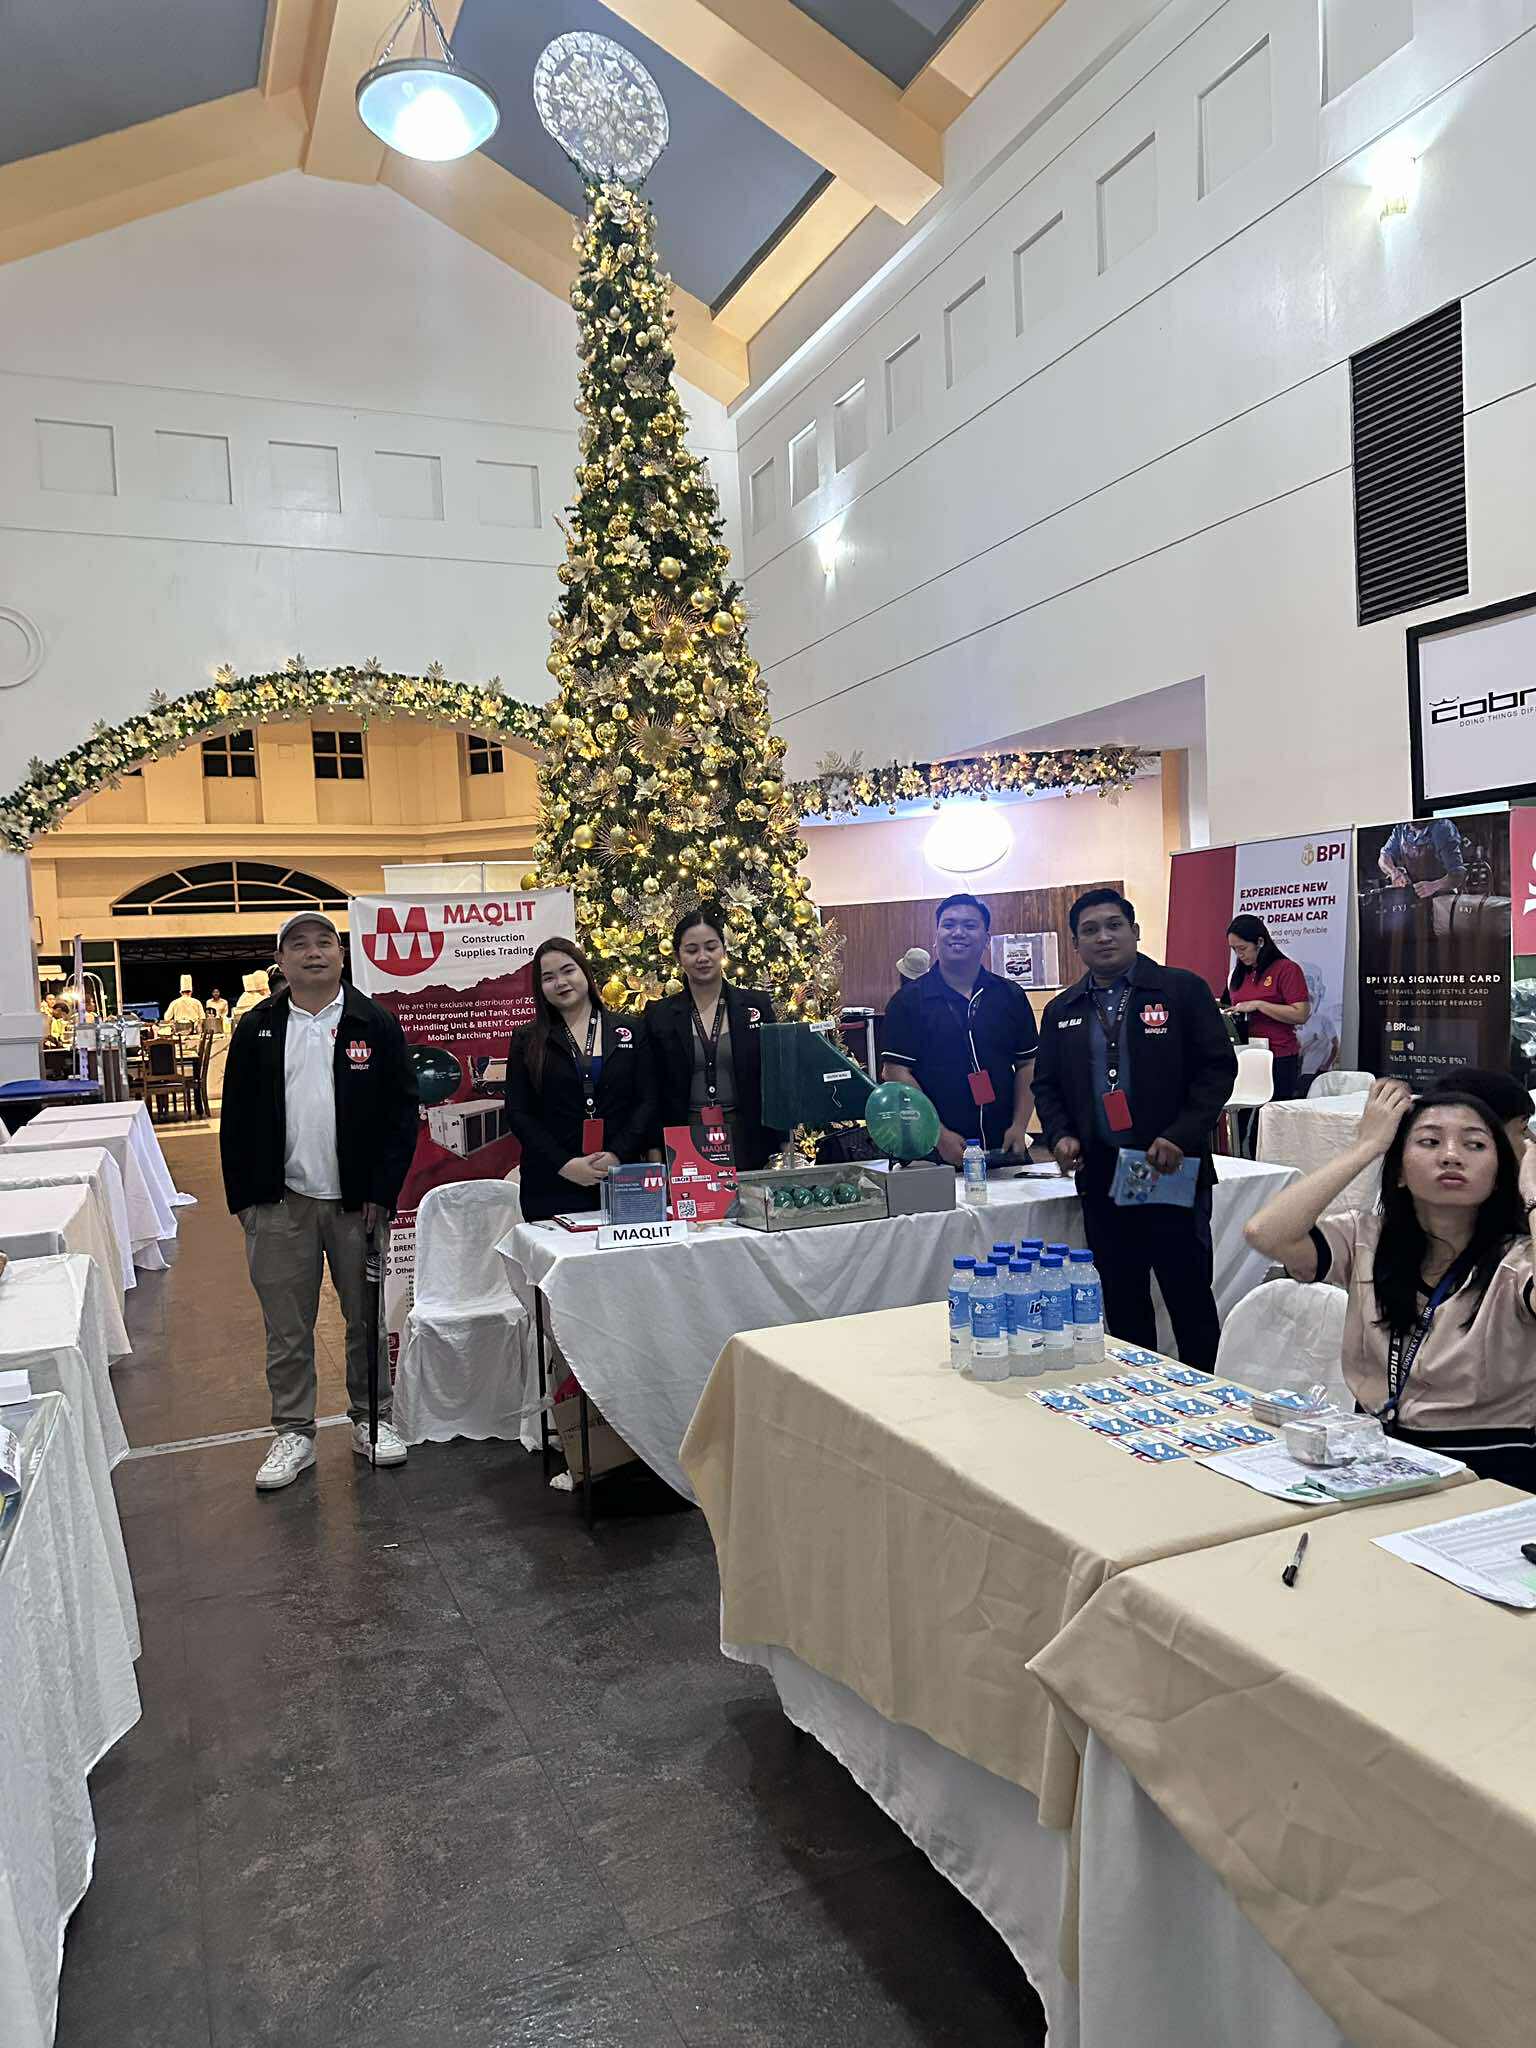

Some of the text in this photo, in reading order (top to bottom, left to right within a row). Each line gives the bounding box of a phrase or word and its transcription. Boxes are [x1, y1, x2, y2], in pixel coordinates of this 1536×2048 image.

[1460, 716, 1484, 728] DOING
[1488, 710, 1518, 720] THINGS
[1316, 843, 1345, 862] BPI
[1240, 881, 1328, 899] EXPERIENCE NEW
[1239, 895, 1336, 912] ADVENTURES WITH
[443, 901, 536, 926] MAQLIT
[1267, 912, 1303, 923] DREAM
[1306, 910, 1328, 920] CAR
[462, 933, 525, 944] Construction
[1283, 929, 1302, 937] enjoy
[1302, 927, 1328, 935] flexible
[454, 945, 534, 958] Supplies Trading
[1366, 974, 1500, 984] BPI VISA SIGNATURE CARD
[397, 1003, 410, 1011] We
[425, 1001, 438, 1009] the
[440, 1000, 473, 1008] exclusive
[474, 998, 513, 1007] distributor
[399, 1013, 414, 1021] FRP
[416, 1011, 468, 1021] Underground
[488, 1009, 510, 1017] Tank,
[413, 1023, 449, 1031] Handling
[450, 1021, 467, 1030] Unit
[477, 1020, 502, 1028] BRENT
[1393, 1022, 1406, 1032] BPI
[427, 1033, 454, 1041] Mobile
[456, 1031, 491, 1039] Batching
[701, 1144, 730, 1152] MAQLIT
[613, 1226, 671, 1241] MAQLIT
